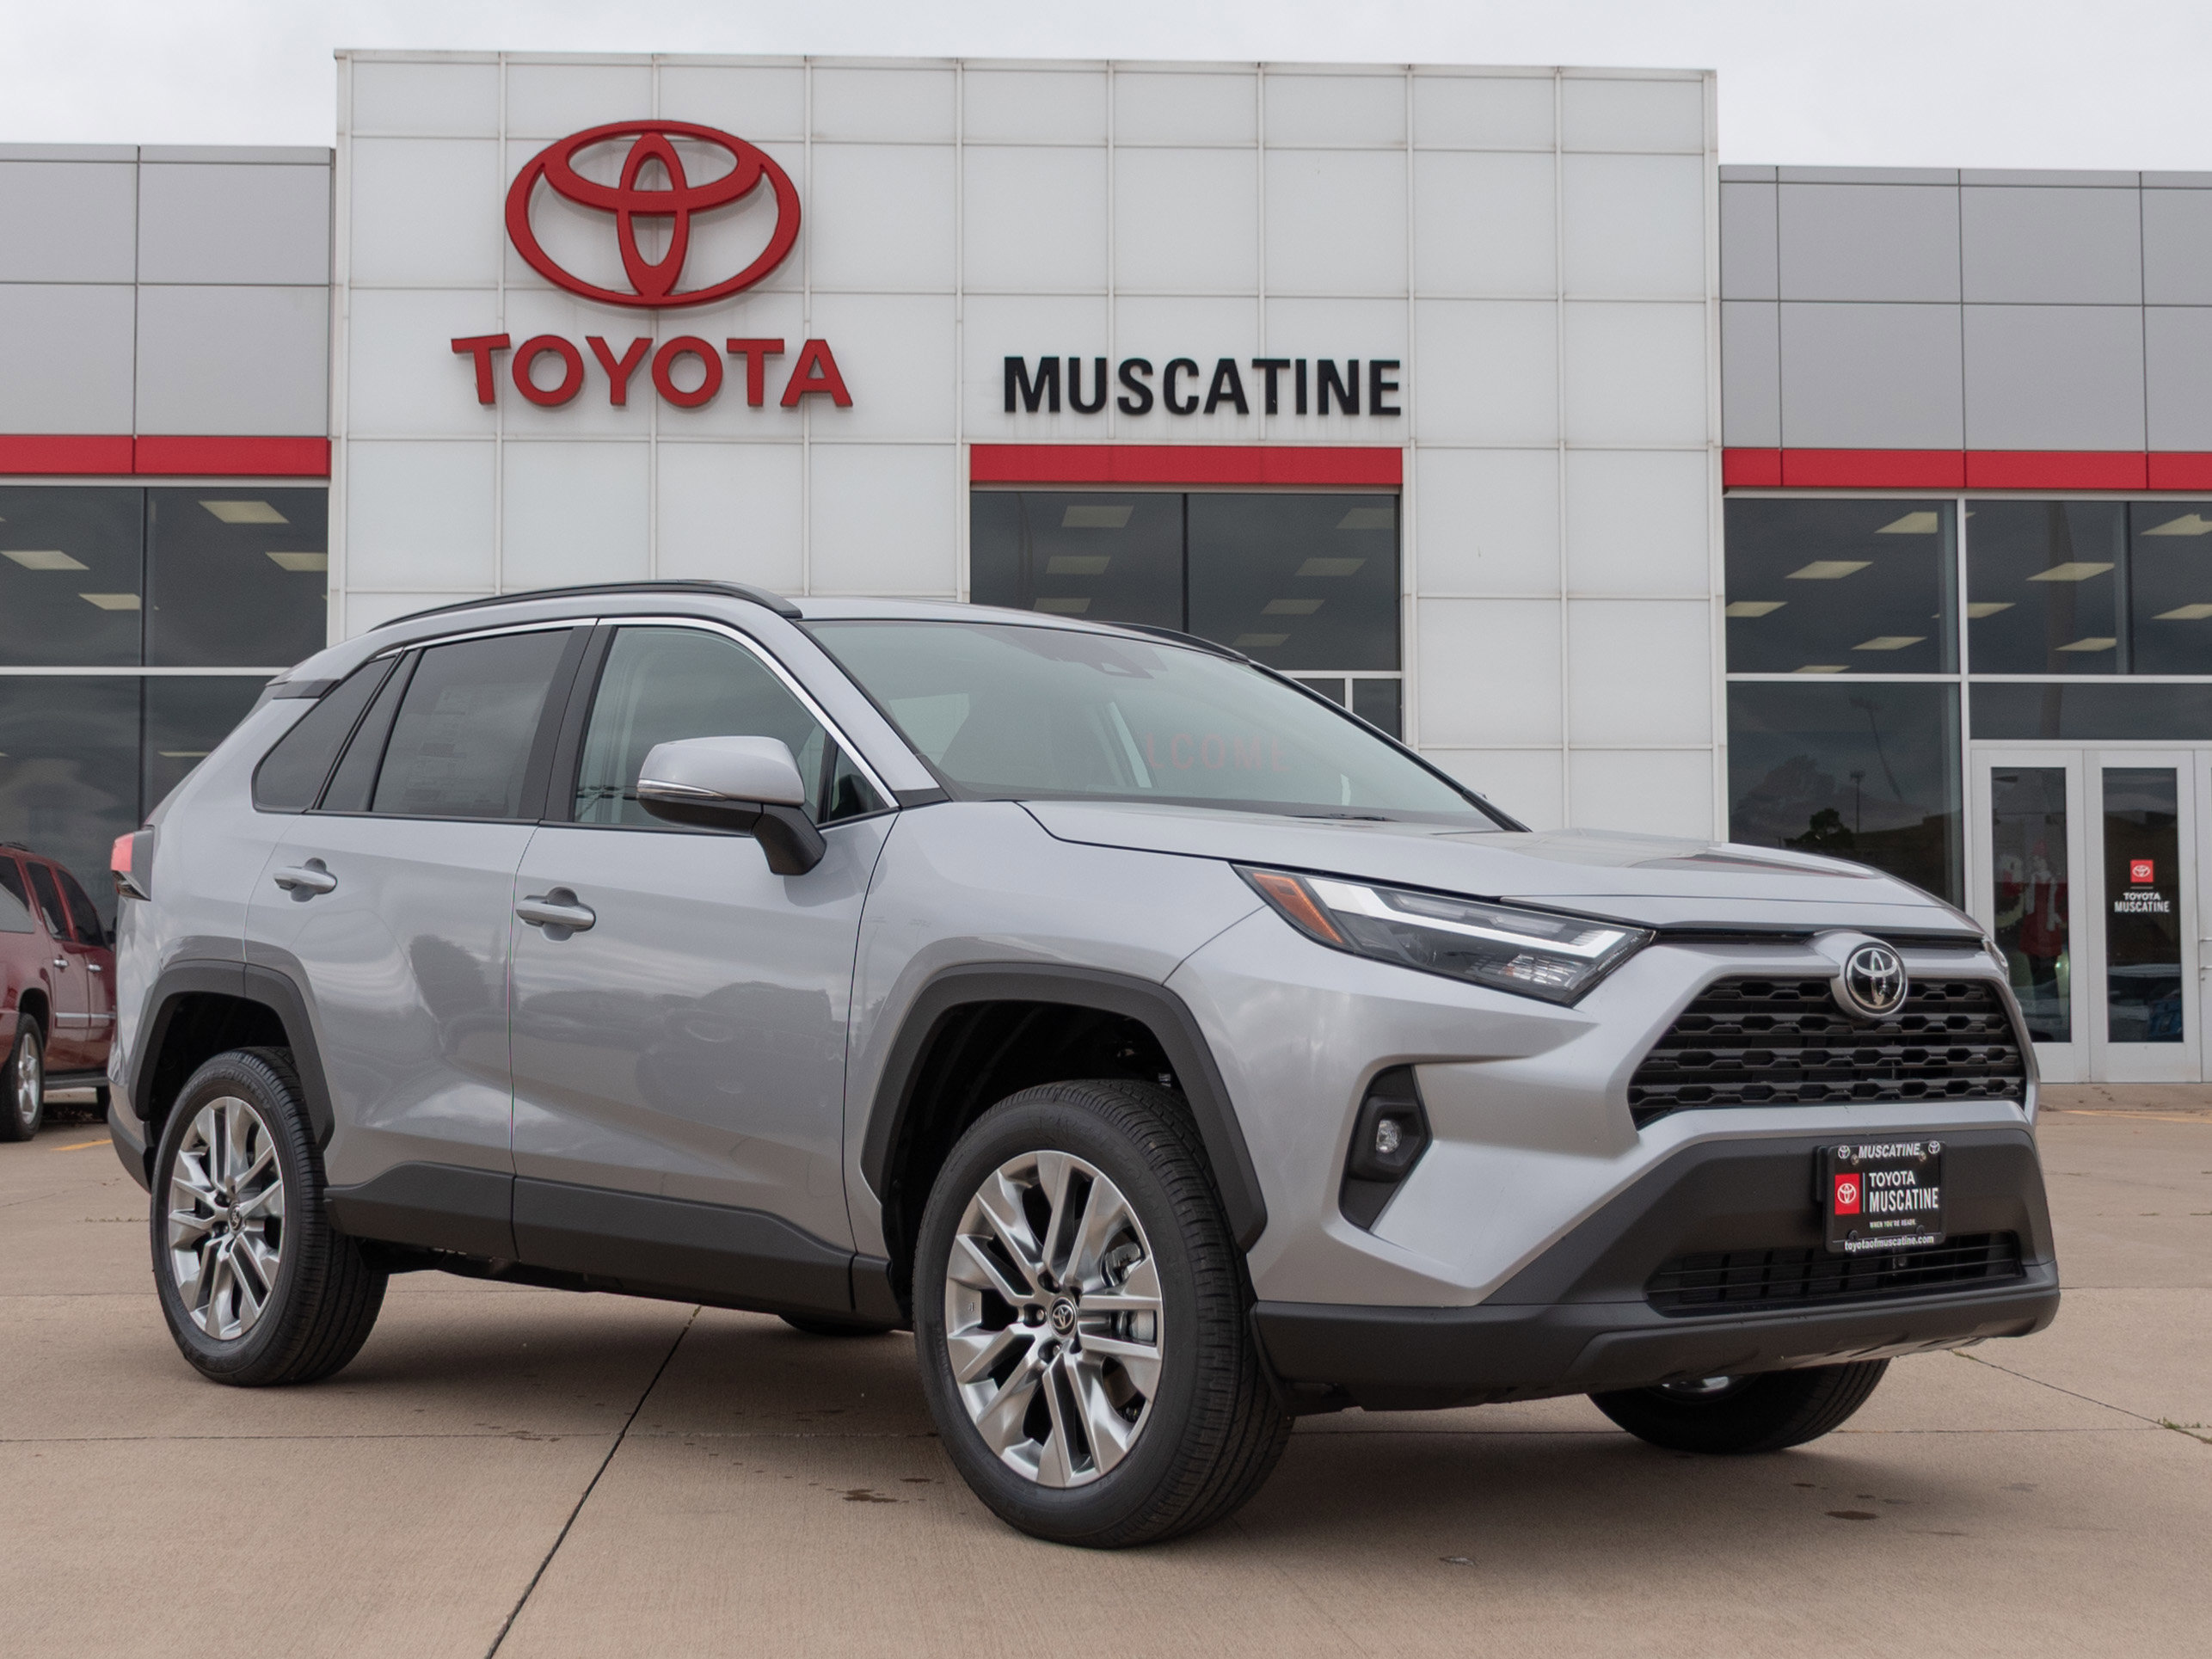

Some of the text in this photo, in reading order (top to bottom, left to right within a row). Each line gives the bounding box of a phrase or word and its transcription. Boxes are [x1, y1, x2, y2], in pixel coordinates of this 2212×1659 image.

[451, 333, 854, 408] TOYOTA
[1004, 356, 1402, 416] MUSCATINE
[2123, 892, 2161, 901] TOYOTA
[2114, 900, 2170, 912] MUSCATINE
[1858, 1142, 1921, 1159] MUSCATINE
[1868, 1170, 1916, 1188] TOYOTA
[1869, 1188, 1939, 1213] MUSCATINE
[1844, 1235, 1934, 1252] toyotaofmuscatine.com
